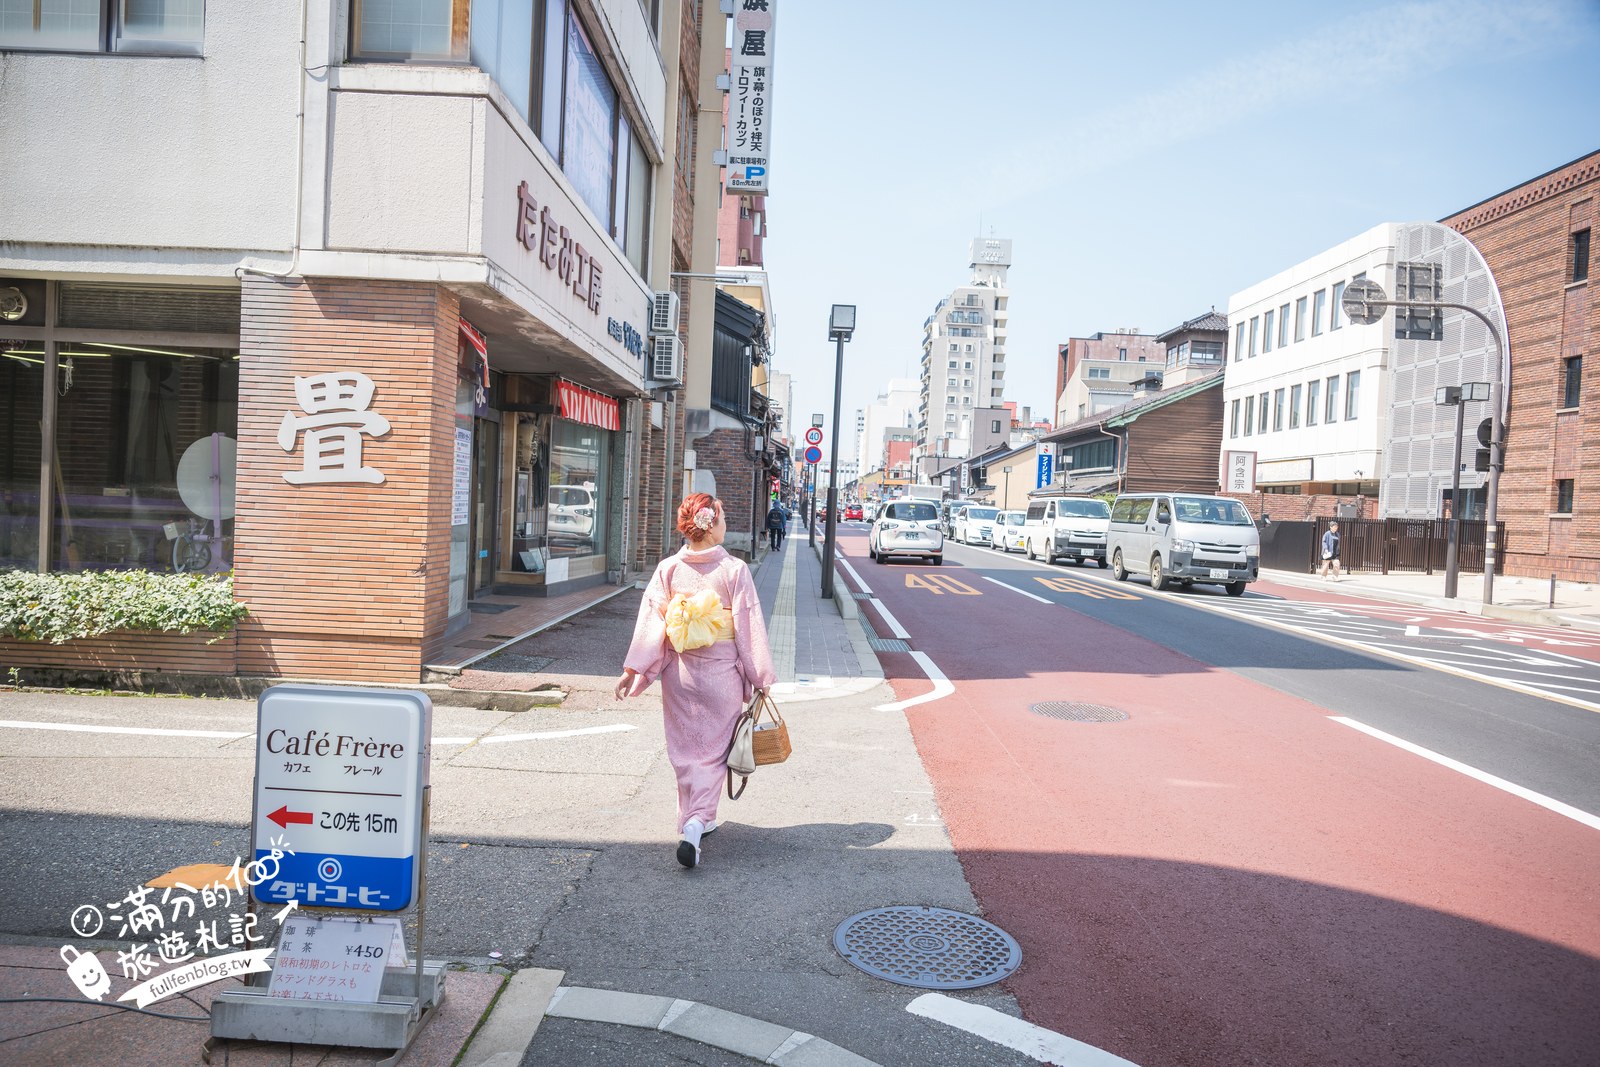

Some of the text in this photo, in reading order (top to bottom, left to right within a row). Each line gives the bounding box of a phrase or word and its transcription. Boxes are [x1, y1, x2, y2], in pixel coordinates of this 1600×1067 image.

[736, 66, 749, 147] トロフィー・カップ
[515, 180, 604, 315] たたみ工房
[277, 371, 391, 484] 畳
[809, 432, 819, 441] 40
[1234, 455, 1246, 489] 阿含宗
[905, 573, 984, 596] 40
[266, 728, 404, 760] Café Frère
[283, 761, 383, 777] カフェ フレール
[320, 811, 398, 834] この先 15m
[268, 880, 390, 906] ダートコーヒー
[345, 944, 384, 959] ¥450
[279, 957, 372, 973] 昭和初期のレトロな
[275, 973, 358, 989] ステンドグラスも
